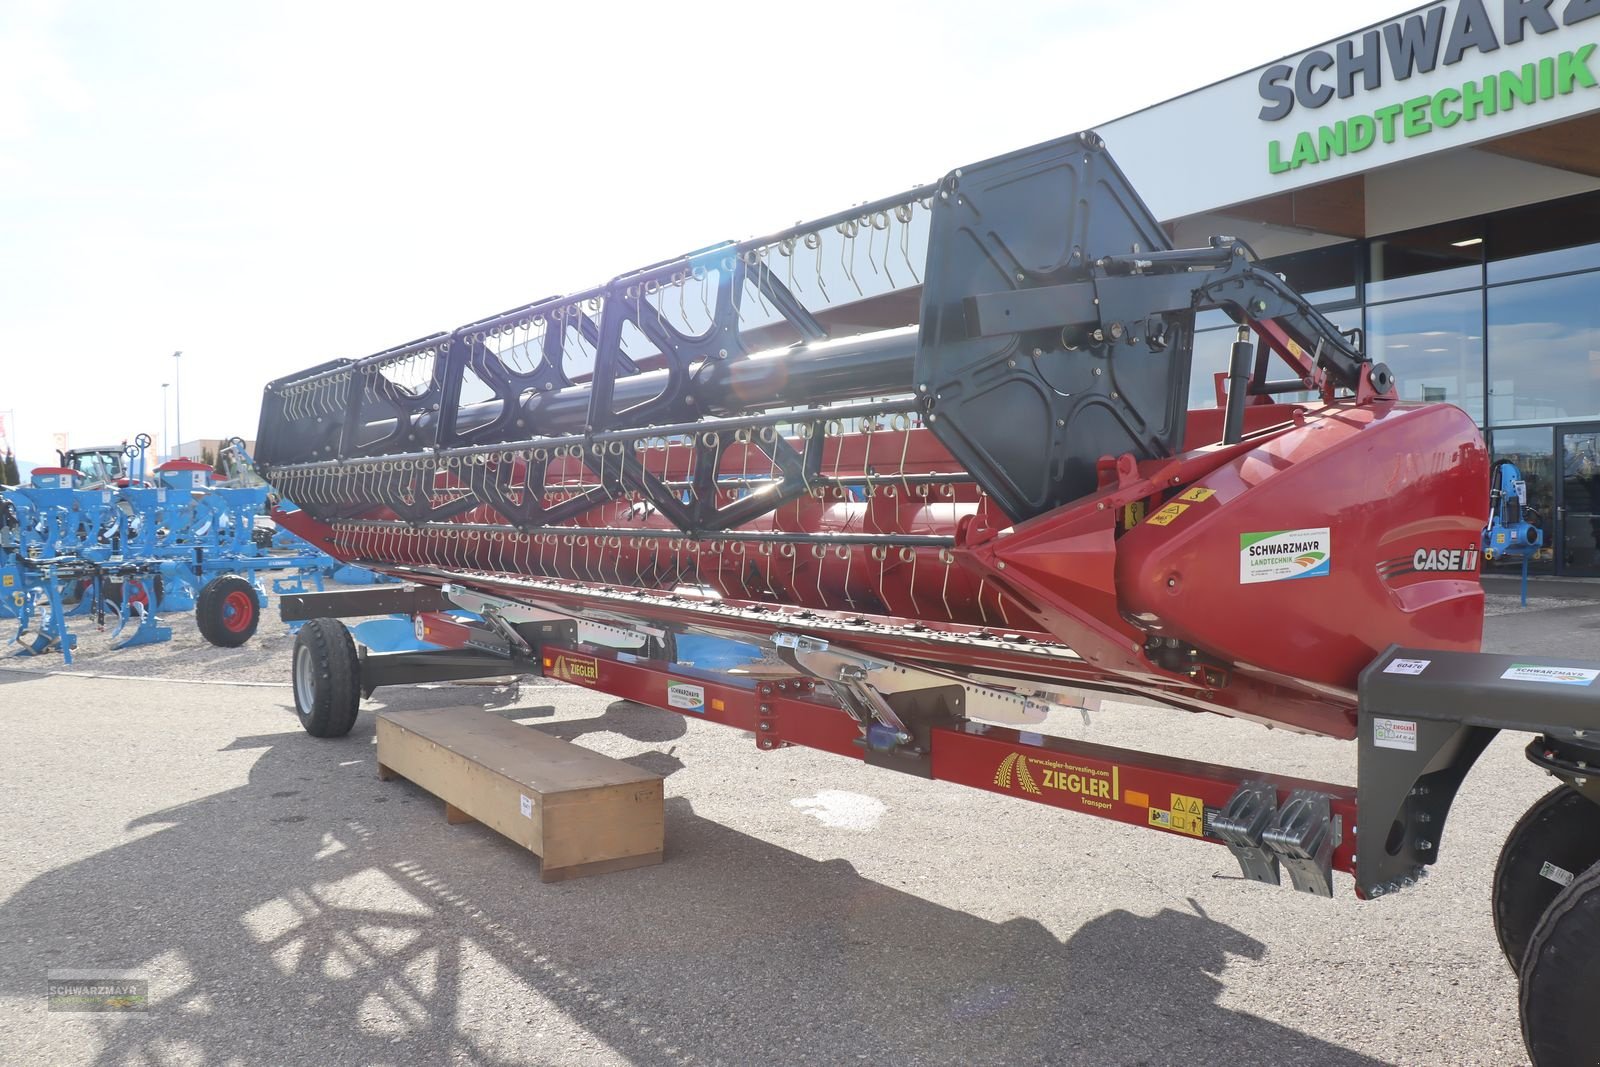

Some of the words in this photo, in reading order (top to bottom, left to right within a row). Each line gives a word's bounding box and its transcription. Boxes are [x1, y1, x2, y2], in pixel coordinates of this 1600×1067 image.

[1268, 43, 1599, 174] LANDTECHNIK
[1249, 541, 1319, 557] SCHWARZMAYR
[1250, 557, 1292, 567] LANDTECHNIK
[1413, 549, 1461, 571] CASE
[570, 663, 595, 679] ZIEGLER
[1515, 668, 1584, 677] SCHWARZMAYR
[671, 687, 700, 698] SCHWARZMAYR
[1028, 758, 1109, 777] www.ziegler-harvesting.com
[1042, 769, 1110, 799] ZIEGLER
[1081, 797, 1112, 809] Transport
